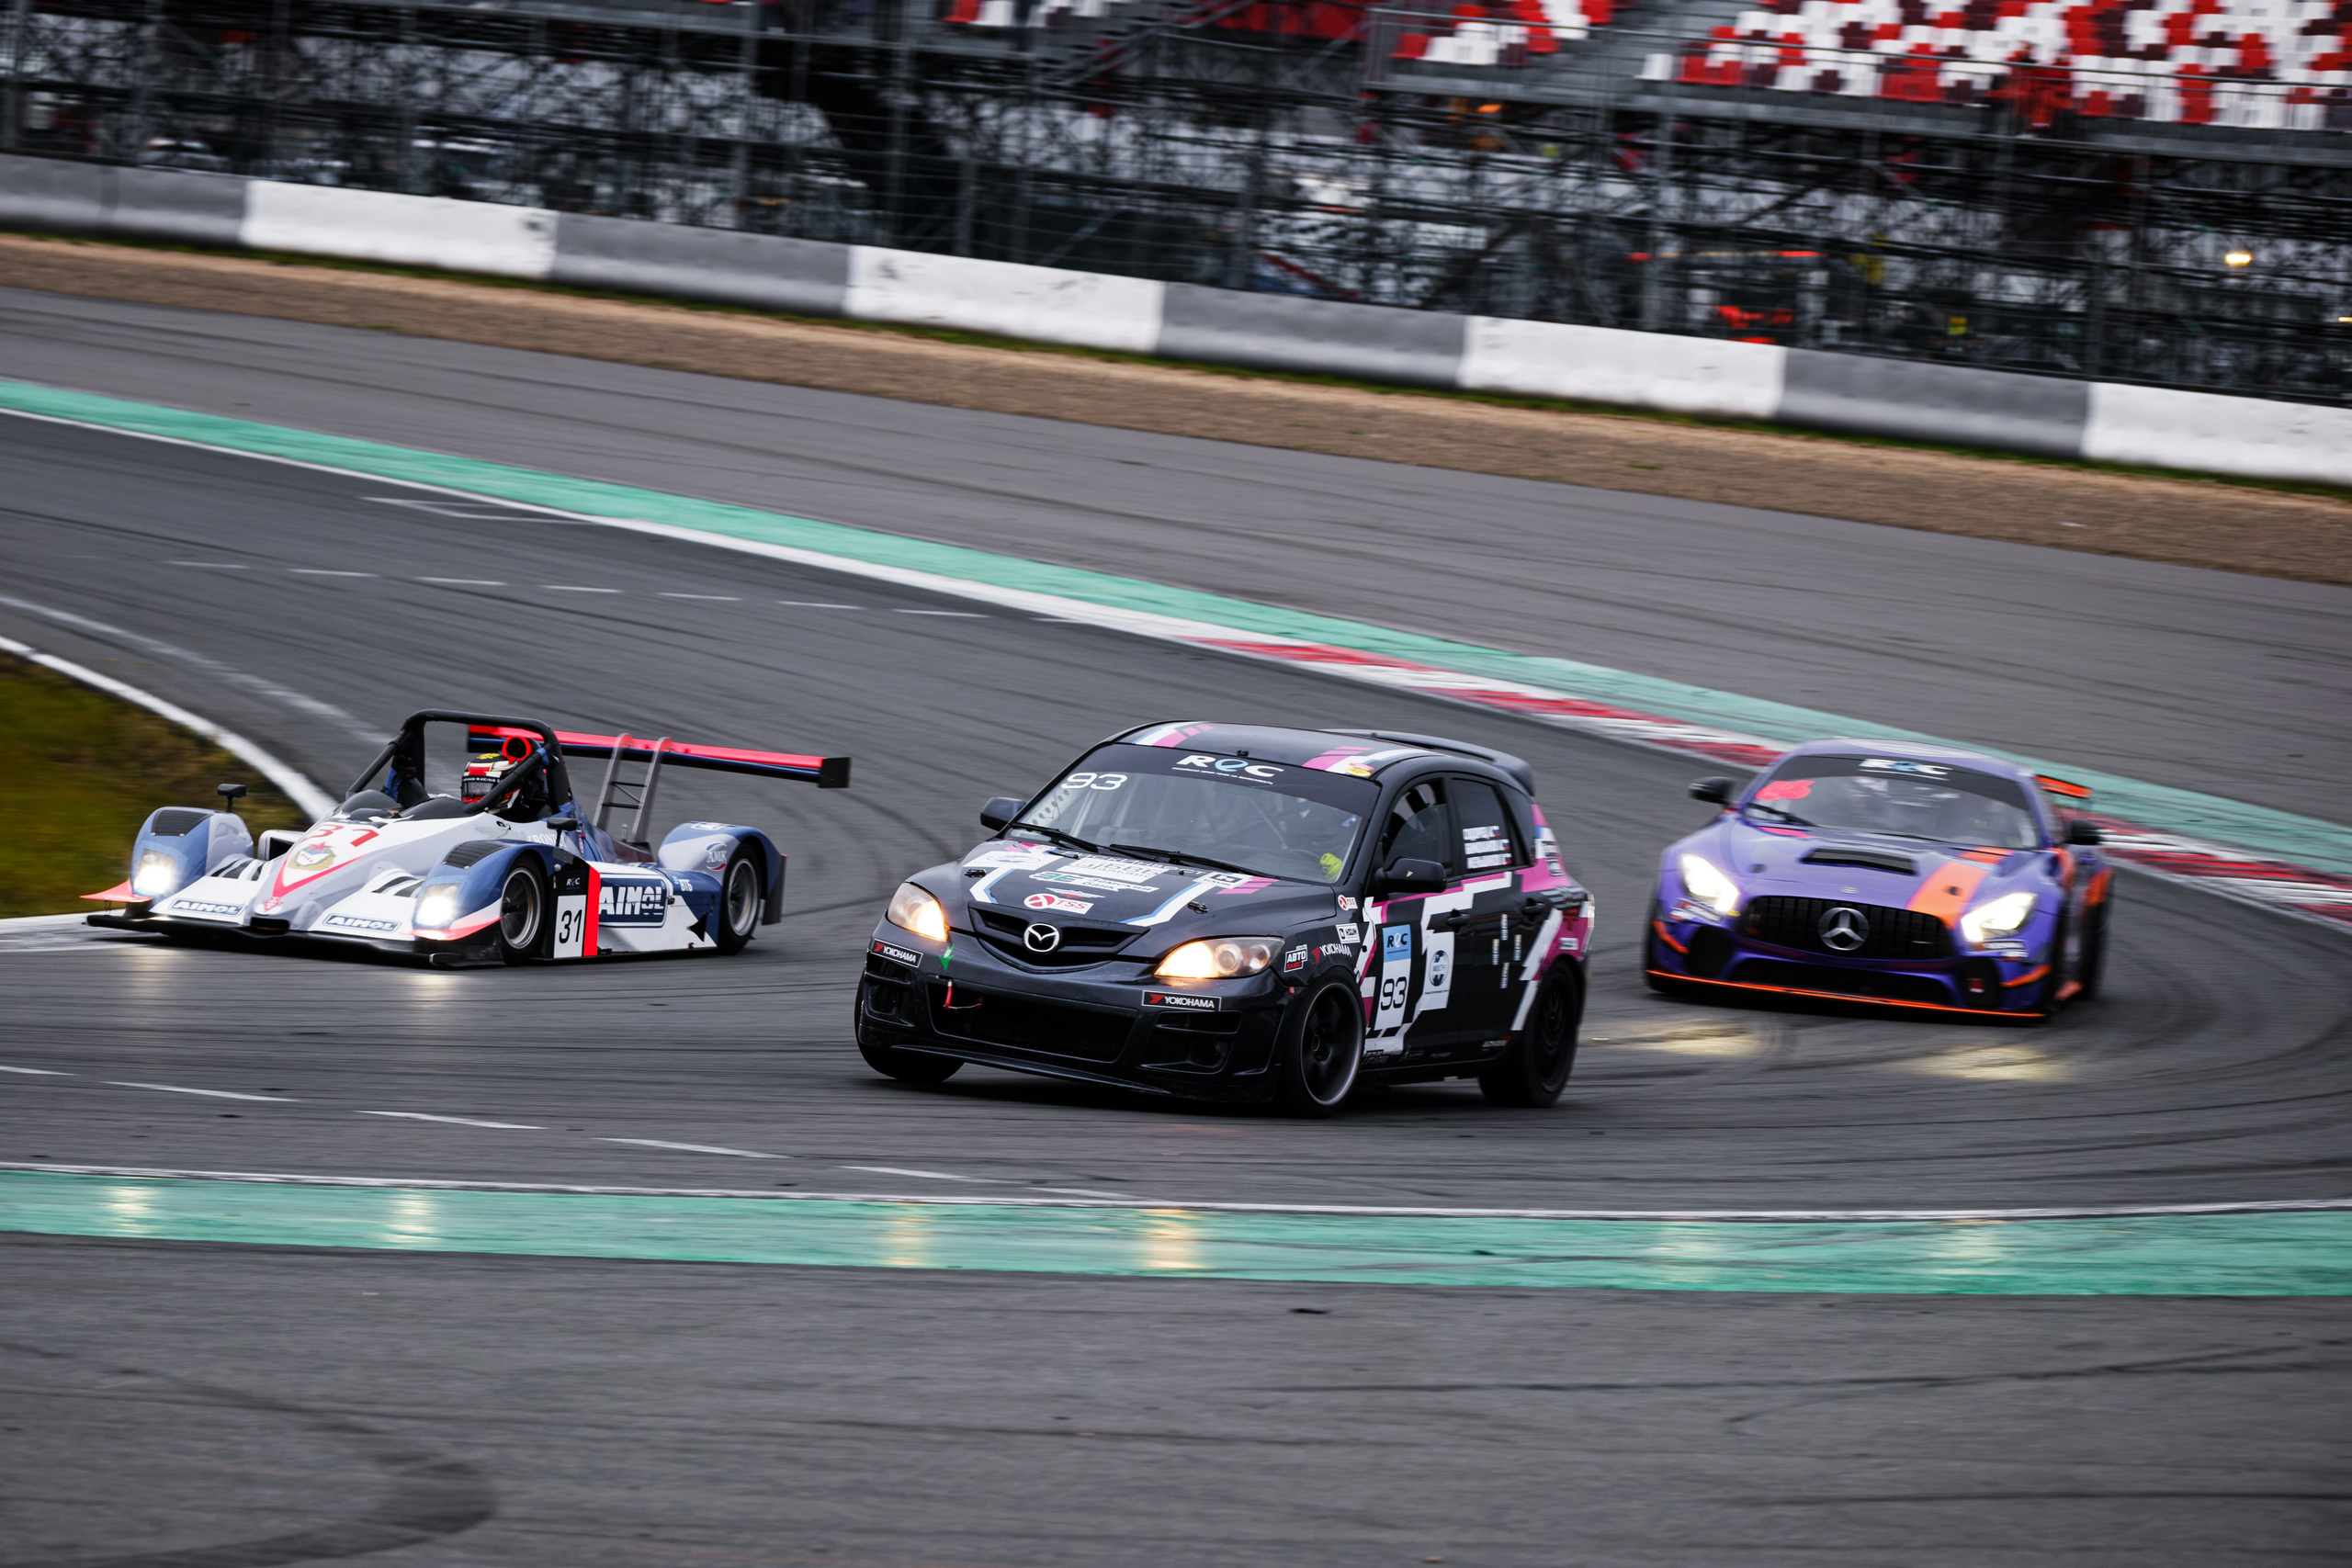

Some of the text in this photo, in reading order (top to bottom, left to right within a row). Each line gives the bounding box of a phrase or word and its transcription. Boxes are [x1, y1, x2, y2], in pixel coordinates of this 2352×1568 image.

[1061, 772, 1128, 791] 93
[300, 824, 379, 848] 31
[172, 900, 239, 915] AIMOL
[599, 886, 664, 915] AIMOL
[1057, 899, 1088, 909] TSS
[327, 916, 394, 931] AIMOL
[559, 909, 583, 944] 31
[883, 945, 917, 964] YOKOHAMA
[1286, 950, 1306, 964] АВТО
[1319, 942, 1352, 957] YOKOHAMA
[1380, 976, 1408, 1010] 93
[1164, 996, 1215, 1009] YOKOHAMA
